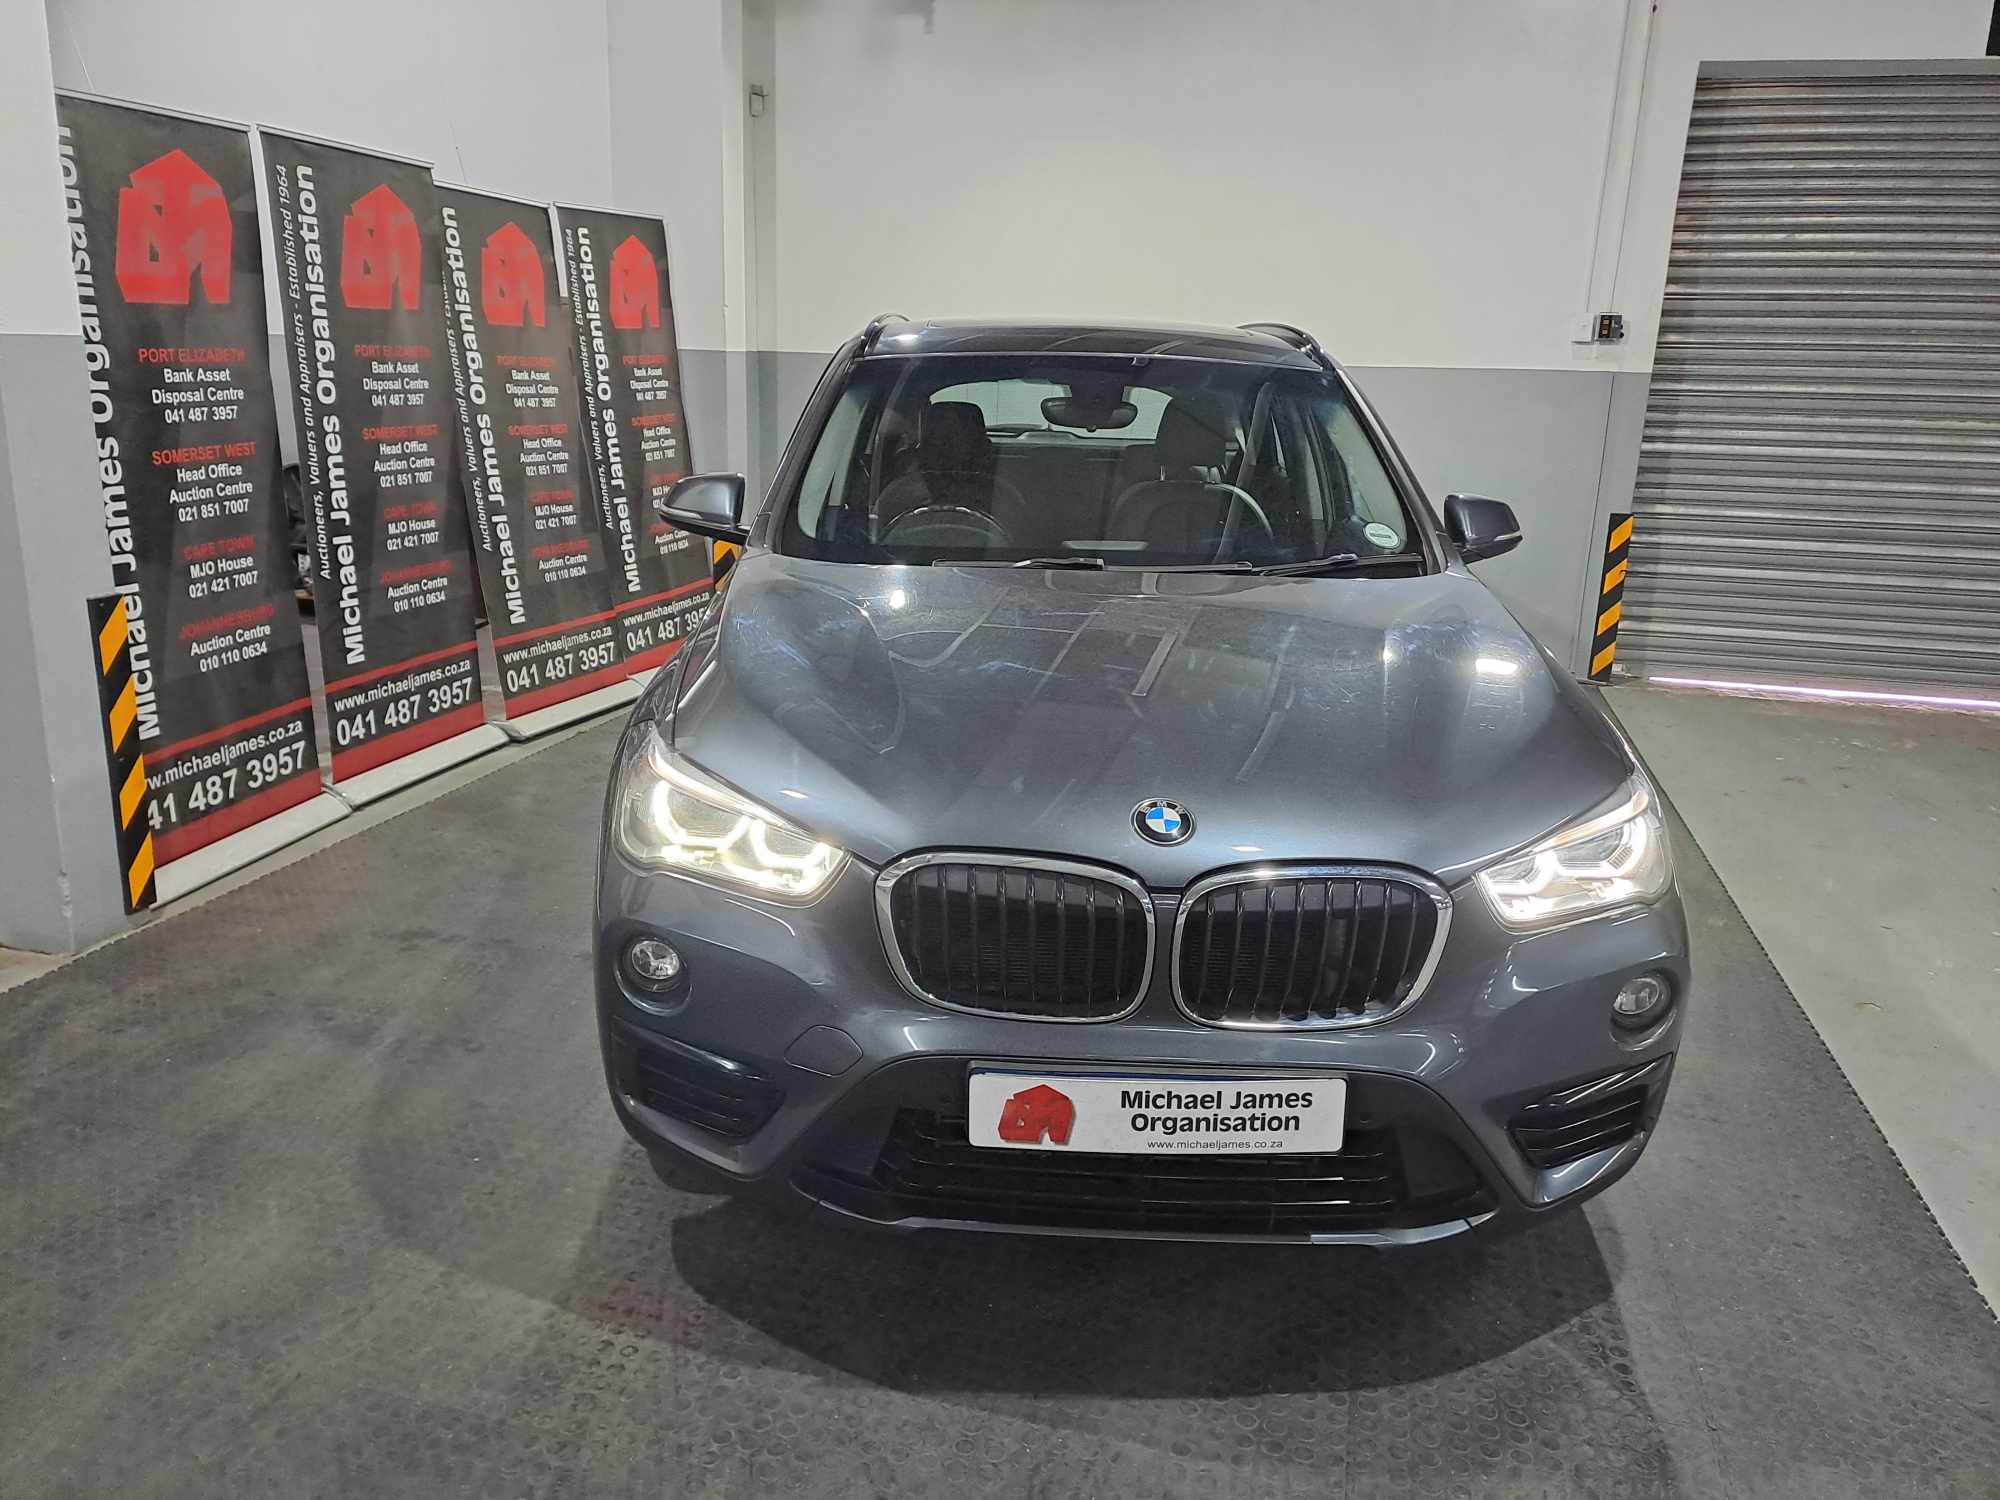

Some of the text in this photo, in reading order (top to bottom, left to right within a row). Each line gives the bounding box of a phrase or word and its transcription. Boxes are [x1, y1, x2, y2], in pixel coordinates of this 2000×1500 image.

[276, 164, 290, 204] 1964
[280, 206, 300, 300] Established
[139, 348, 176, 362] PORT
[294, 313, 312, 394] Appraisers
[372, 362, 420, 374] Bank Asset
[447, 328, 465, 396] Appraisers
[164, 368, 231, 382] Bank Asset
[362, 378, 429, 392] Disposal Centre
[152, 387, 244, 405] Disposal Centre
[372, 394, 424, 406] 041 487 3957
[456, 398, 469, 423] and
[577, 227, 641, 592] Michael James Organisation
[165, 406, 238, 423] 041 487 3957
[297, 165, 365, 664] Michael James Organisation
[301, 396, 314, 427] and
[442, 207, 526, 624] Michael James Organisation
[152, 442, 256, 464] SOMERSET WEST
[306, 431, 320, 485] Valuers
[380, 441, 428, 455] Head Office
[464, 426, 476, 472] Valuers
[177, 464, 242, 482] Head Office
[374, 456, 435, 472] Auction Centre
[97, 435, 137, 573] James
[169, 481, 253, 504] Auction Centre
[178, 499, 248, 522] 021 851 7007
[470, 476, 492, 550] Auctioneers,
[312, 490, 330, 580] Auctioneers,
[387, 532, 439, 550] 021 421 7007
[388, 518, 436, 534] MJO House
[190, 556, 254, 578] MJO House
[189, 571, 258, 598] 021 421 7007
[388, 577, 448, 598] Auction Centre
[623, 592, 710, 626] www.michaeljames.co.za
[191, 624, 270, 656] Auction Centre
[626, 607, 707, 652] 041 487 395
[200, 642, 268, 672] 010 110 0634
[502, 626, 612, 664] www.michaeljames.co.za
[506, 642, 615, 693] 041 487 3957
[334, 660, 470, 712] www.michaeljames.co.za
[337, 677, 472, 746] 041 487 3957
[147, 720, 302, 790] w.michaeljames.co.za
[148, 740, 306, 830] 41 487 3957
[1120, 1089, 1313, 1110] Michael James
[1131, 1112, 1300, 1136] Organisation
[1147, 1140, 1283, 1151] www.michaeljames.co.za
